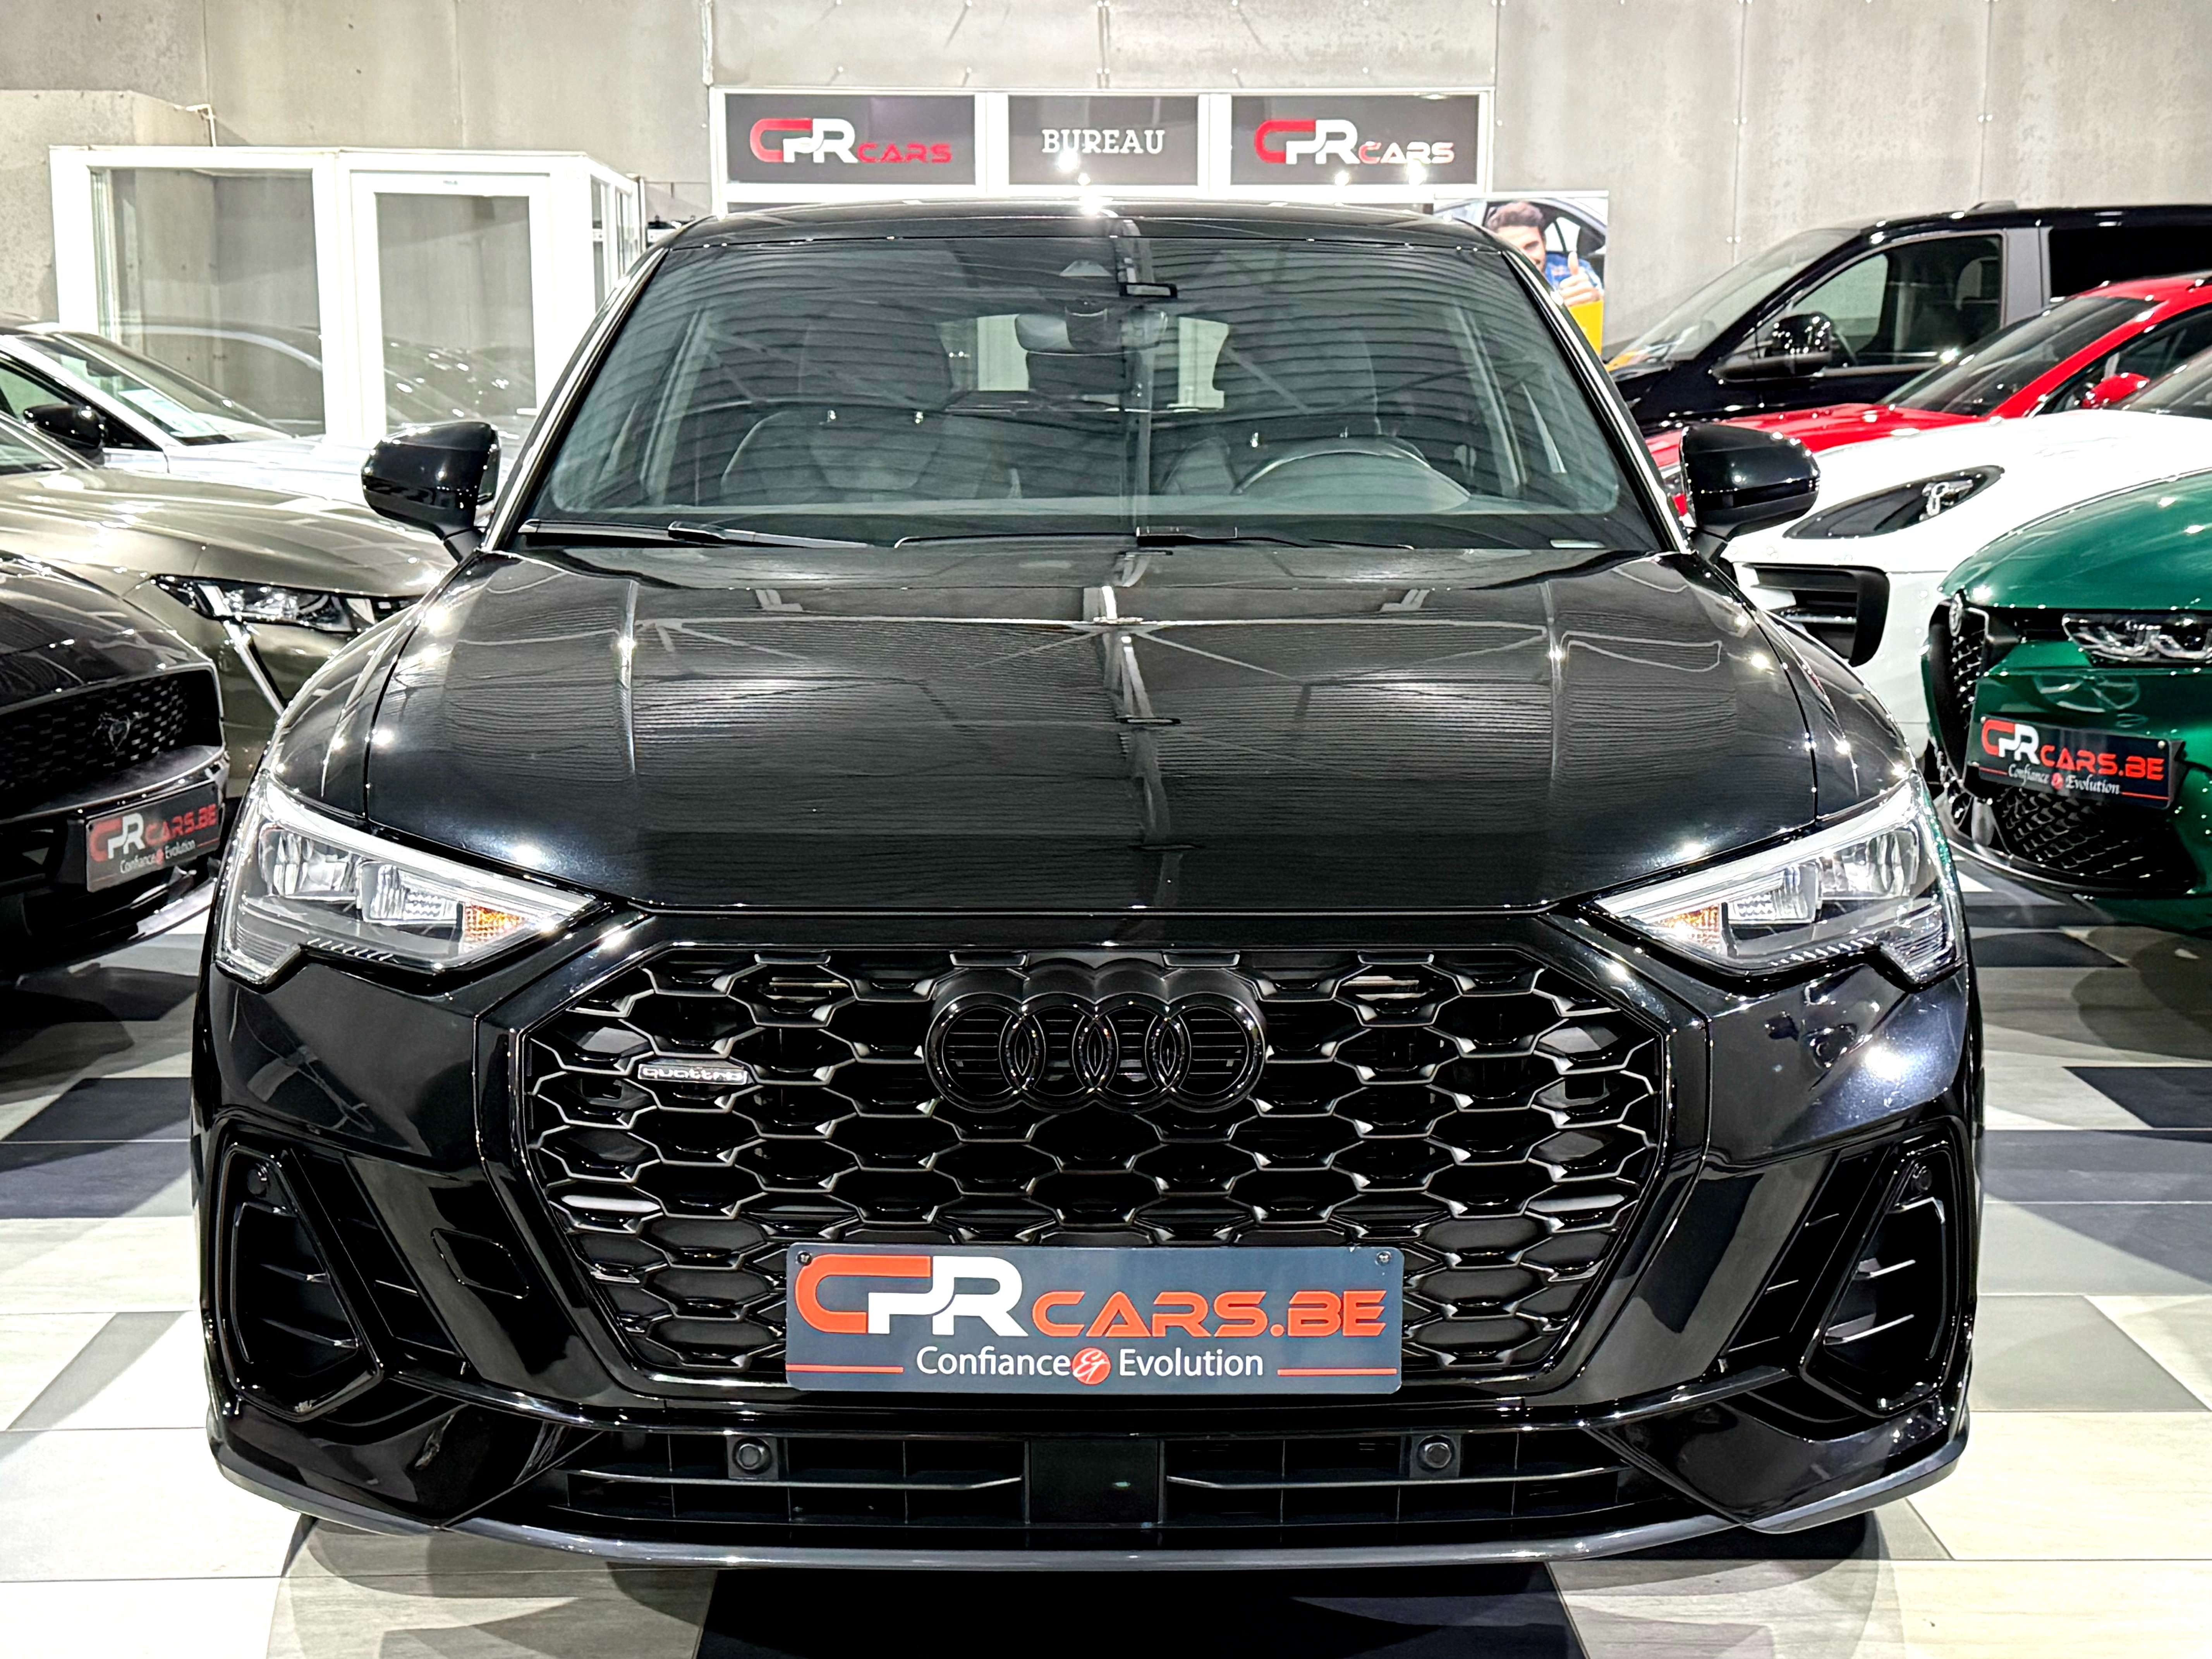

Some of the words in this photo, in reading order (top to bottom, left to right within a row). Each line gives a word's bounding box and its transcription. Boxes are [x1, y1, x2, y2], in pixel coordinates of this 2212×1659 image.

[750, 118, 858, 163] CPR
[857, 143, 953, 163] CARS
[1042, 129, 1165, 154] BUREAU
[1254, 119, 1360, 164] CPR
[1358, 141, 1454, 163] CARS
[1982, 719, 2040, 765] CPR
[2040, 744, 2165, 780] CARS.BE
[2009, 764, 2050, 786] Confiance
[2065, 774, 2121, 794] Evolution
[89, 813, 145, 862] CPR
[145, 803, 217, 846] CARS.BE
[642, 1067, 744, 1081] quattro
[795, 1254, 1029, 1337] CPR
[1032, 1290, 1387, 1338] CARS.BE
[917, 1346, 1071, 1376] Confiance
[1119, 1347, 1263, 1376] Evolution
